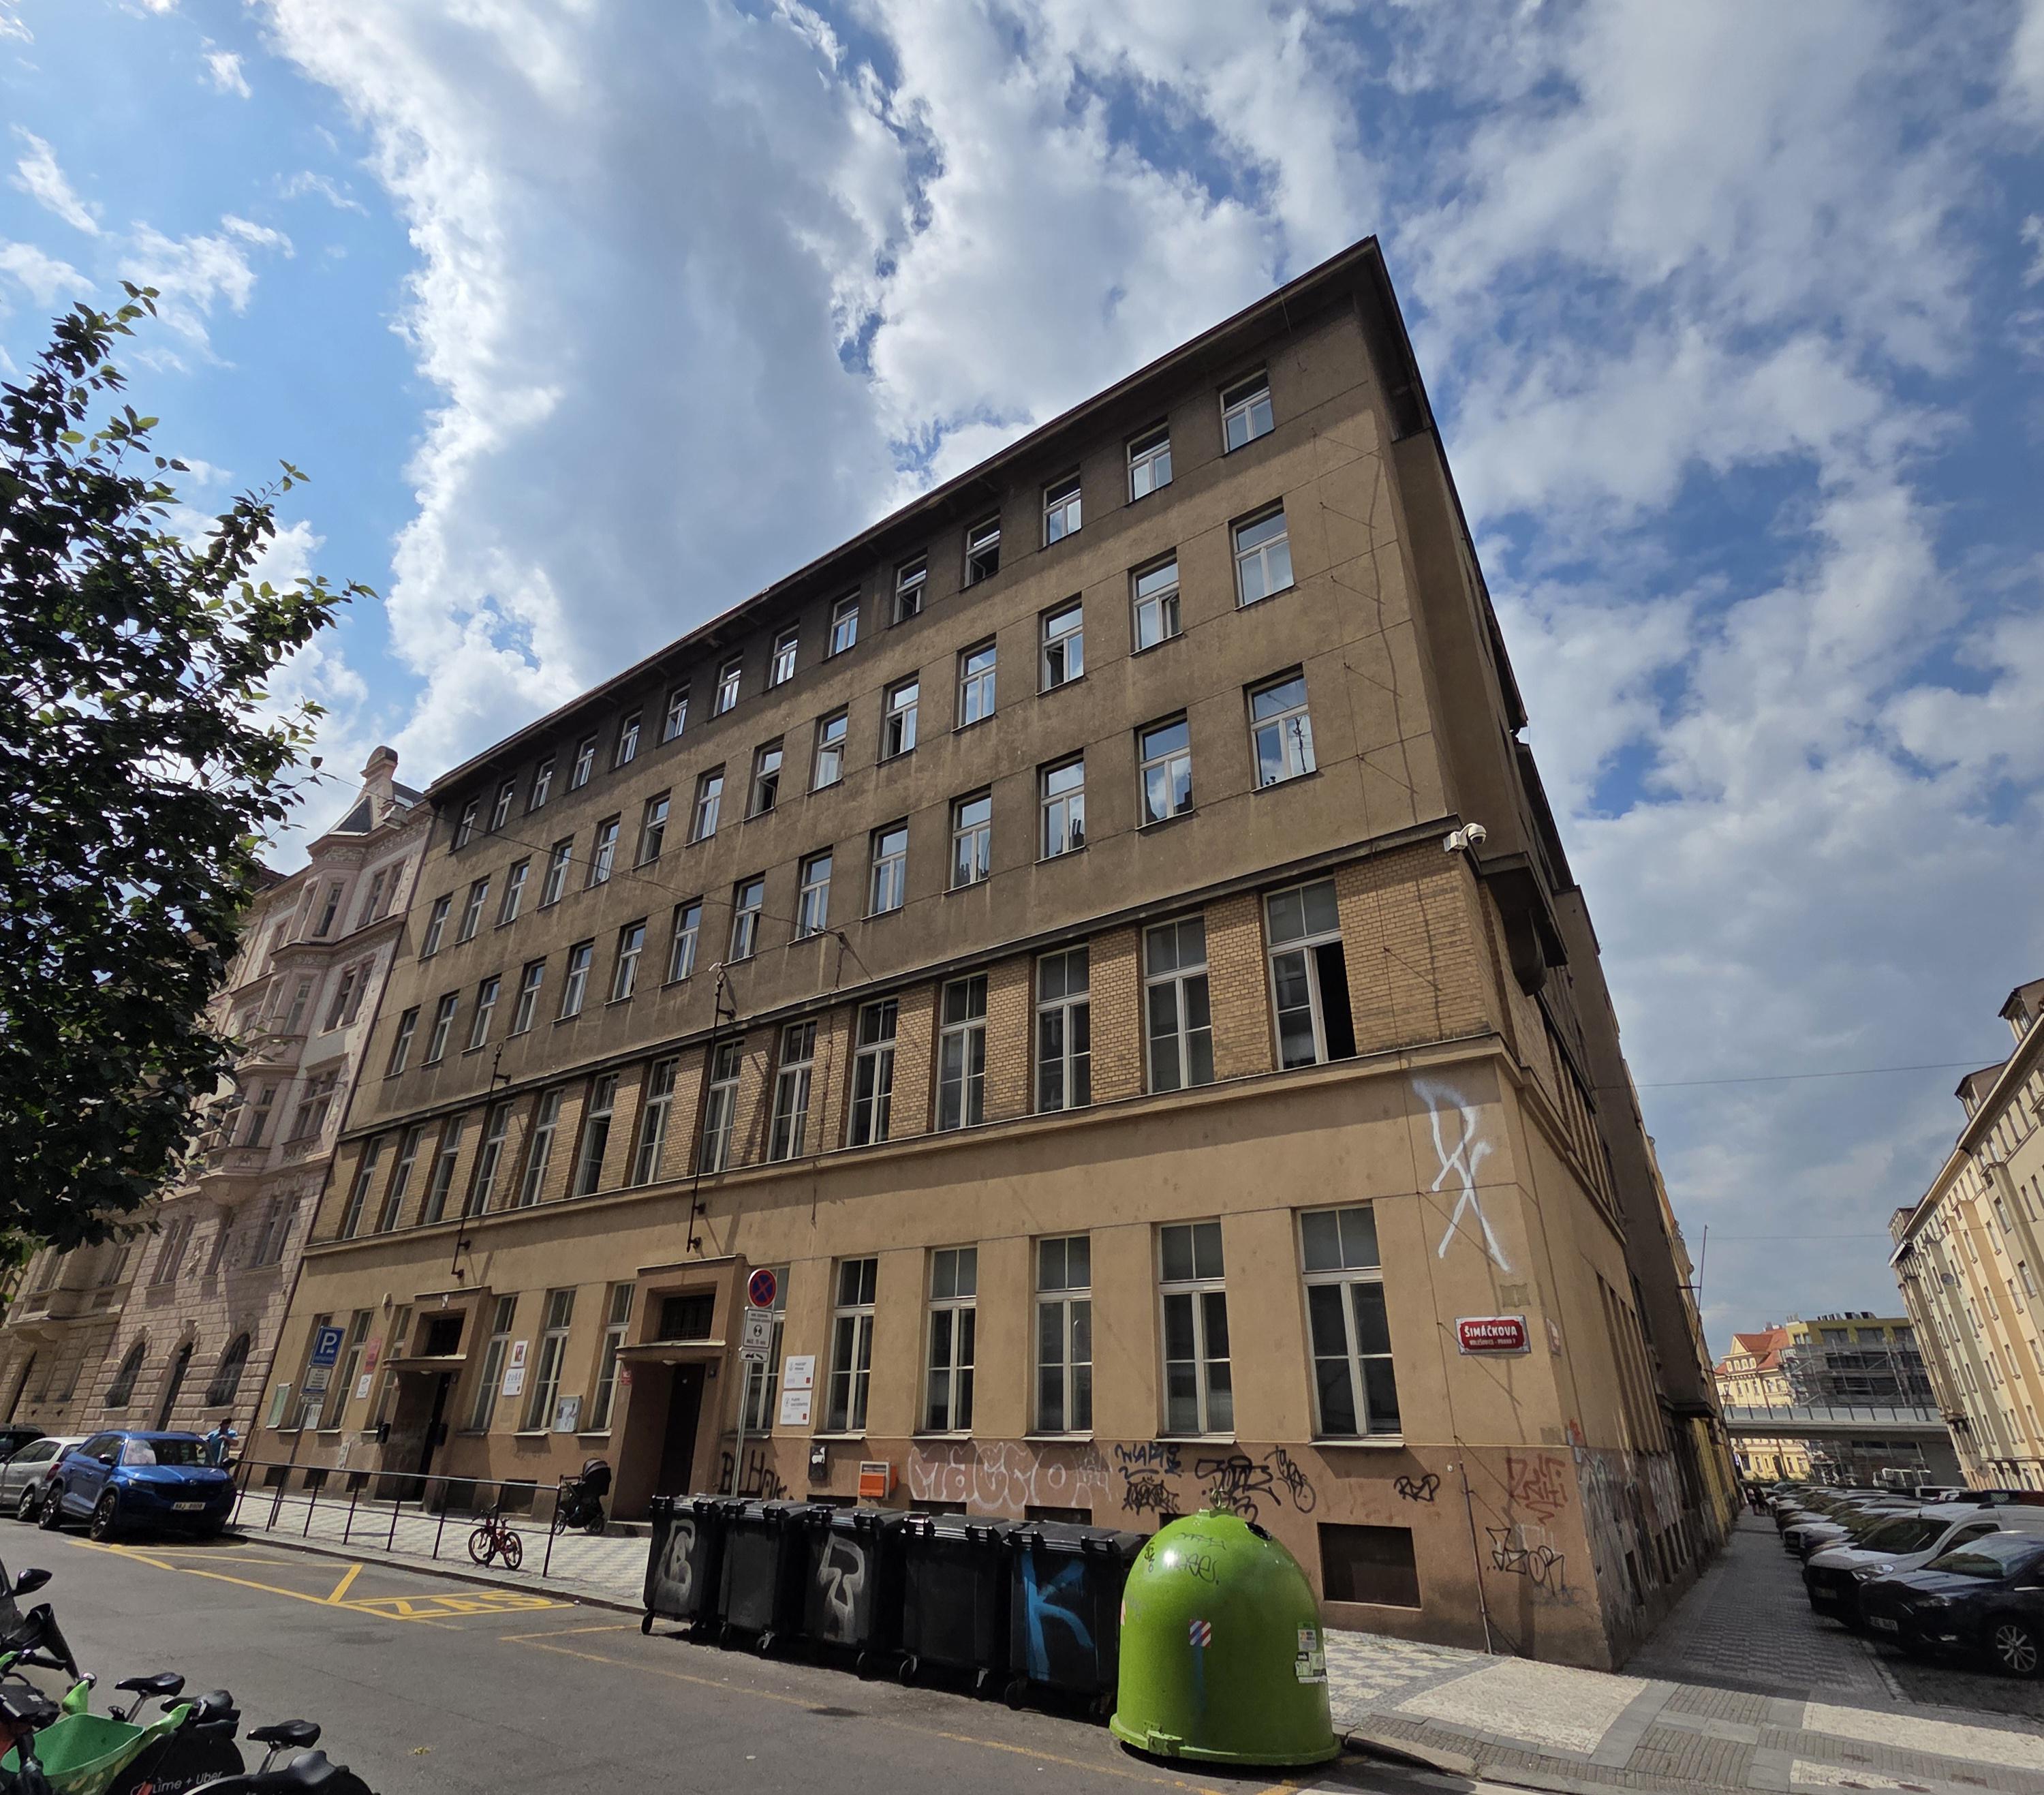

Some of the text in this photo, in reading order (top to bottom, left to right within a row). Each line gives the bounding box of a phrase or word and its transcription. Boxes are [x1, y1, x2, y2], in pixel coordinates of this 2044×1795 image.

[1464, 1324, 1518, 1338] ŠIMÁČKOVA
[320, 1332, 338, 1354] P
[152, 1776, 183, 1794] Lime
[196, 1771, 223, 1785] Uber
